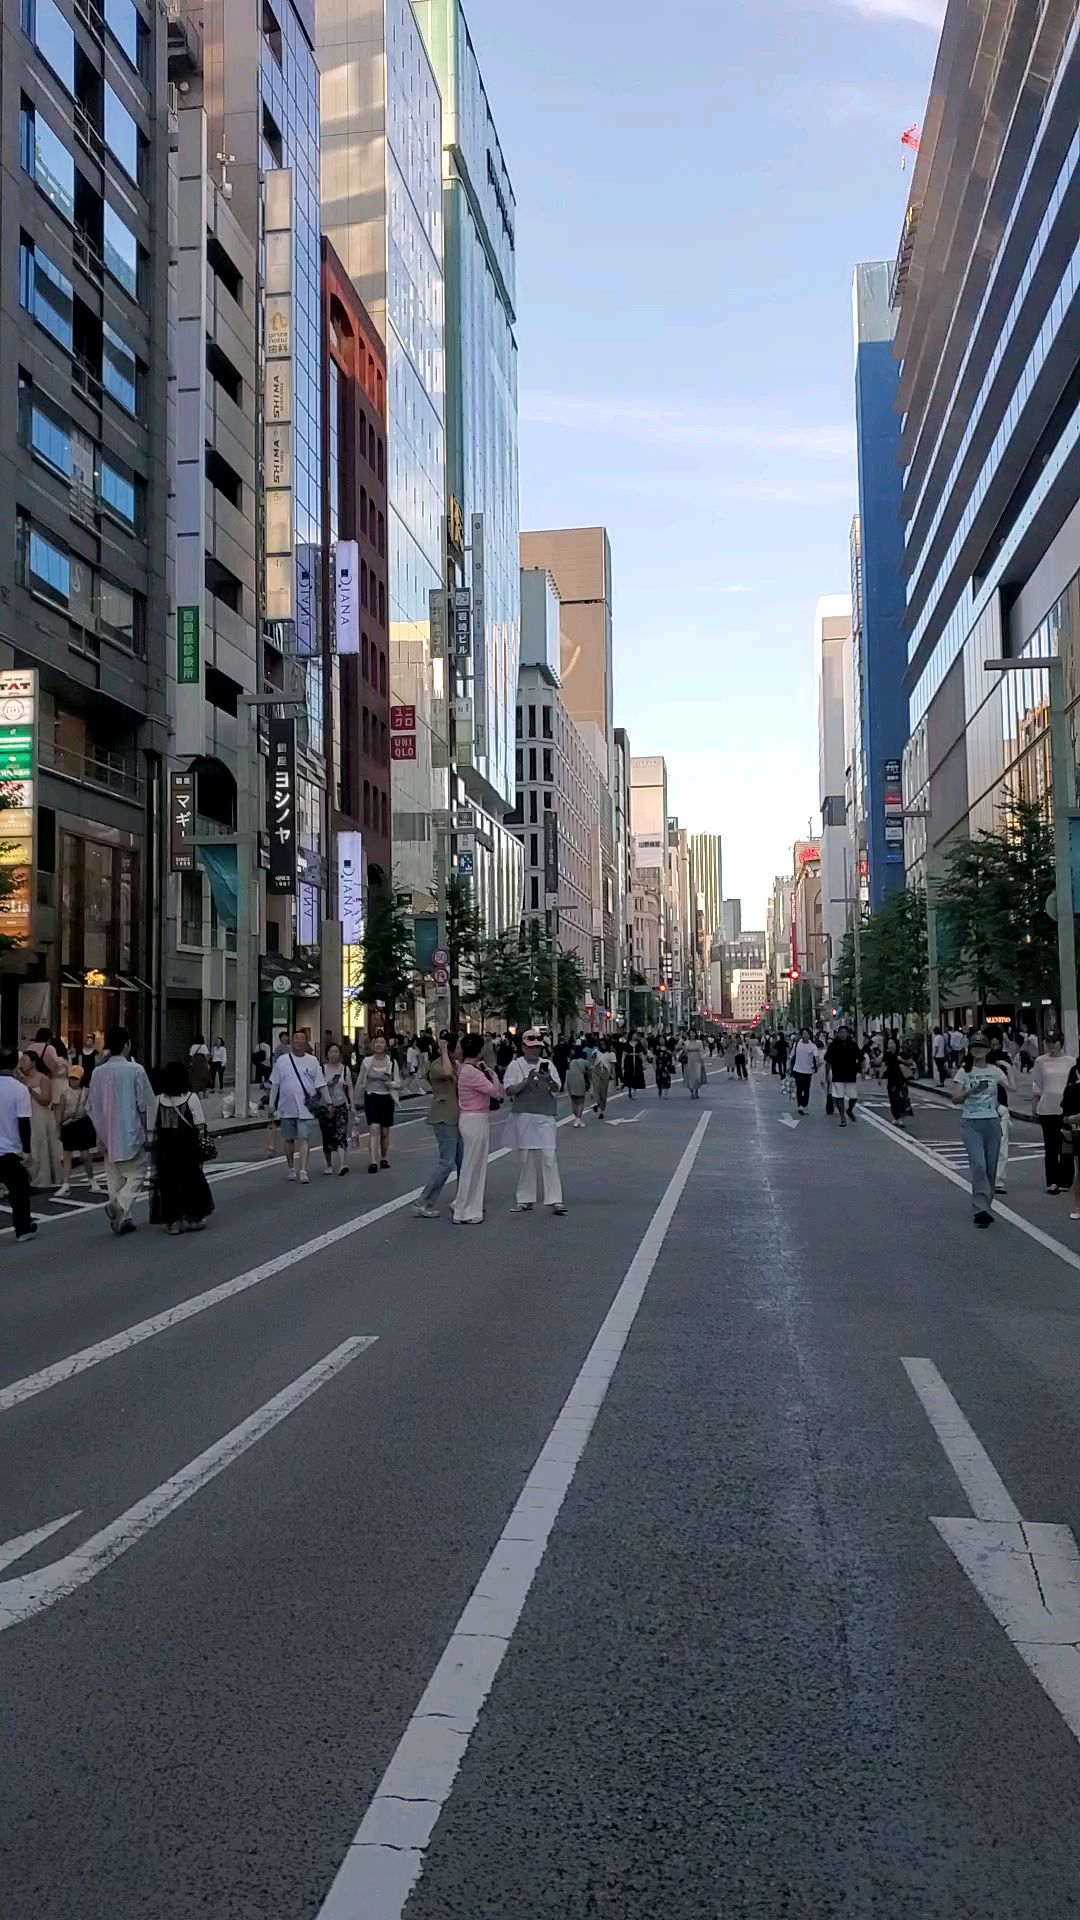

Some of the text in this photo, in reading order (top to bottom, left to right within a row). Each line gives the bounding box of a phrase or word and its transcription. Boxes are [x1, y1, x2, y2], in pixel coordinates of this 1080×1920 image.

[338, 575, 353, 626] DIANA
[0, 682, 31, 691] TAT
[395, 707, 413, 717] ユニ
[395, 718, 413, 727] クロ
[395, 738, 412, 747] UNI
[394, 748, 414, 757] QLO
[274, 771, 291, 844] ヨシノヤ
[175, 794, 192, 838] マギー
[340, 867, 356, 917] DIANA
